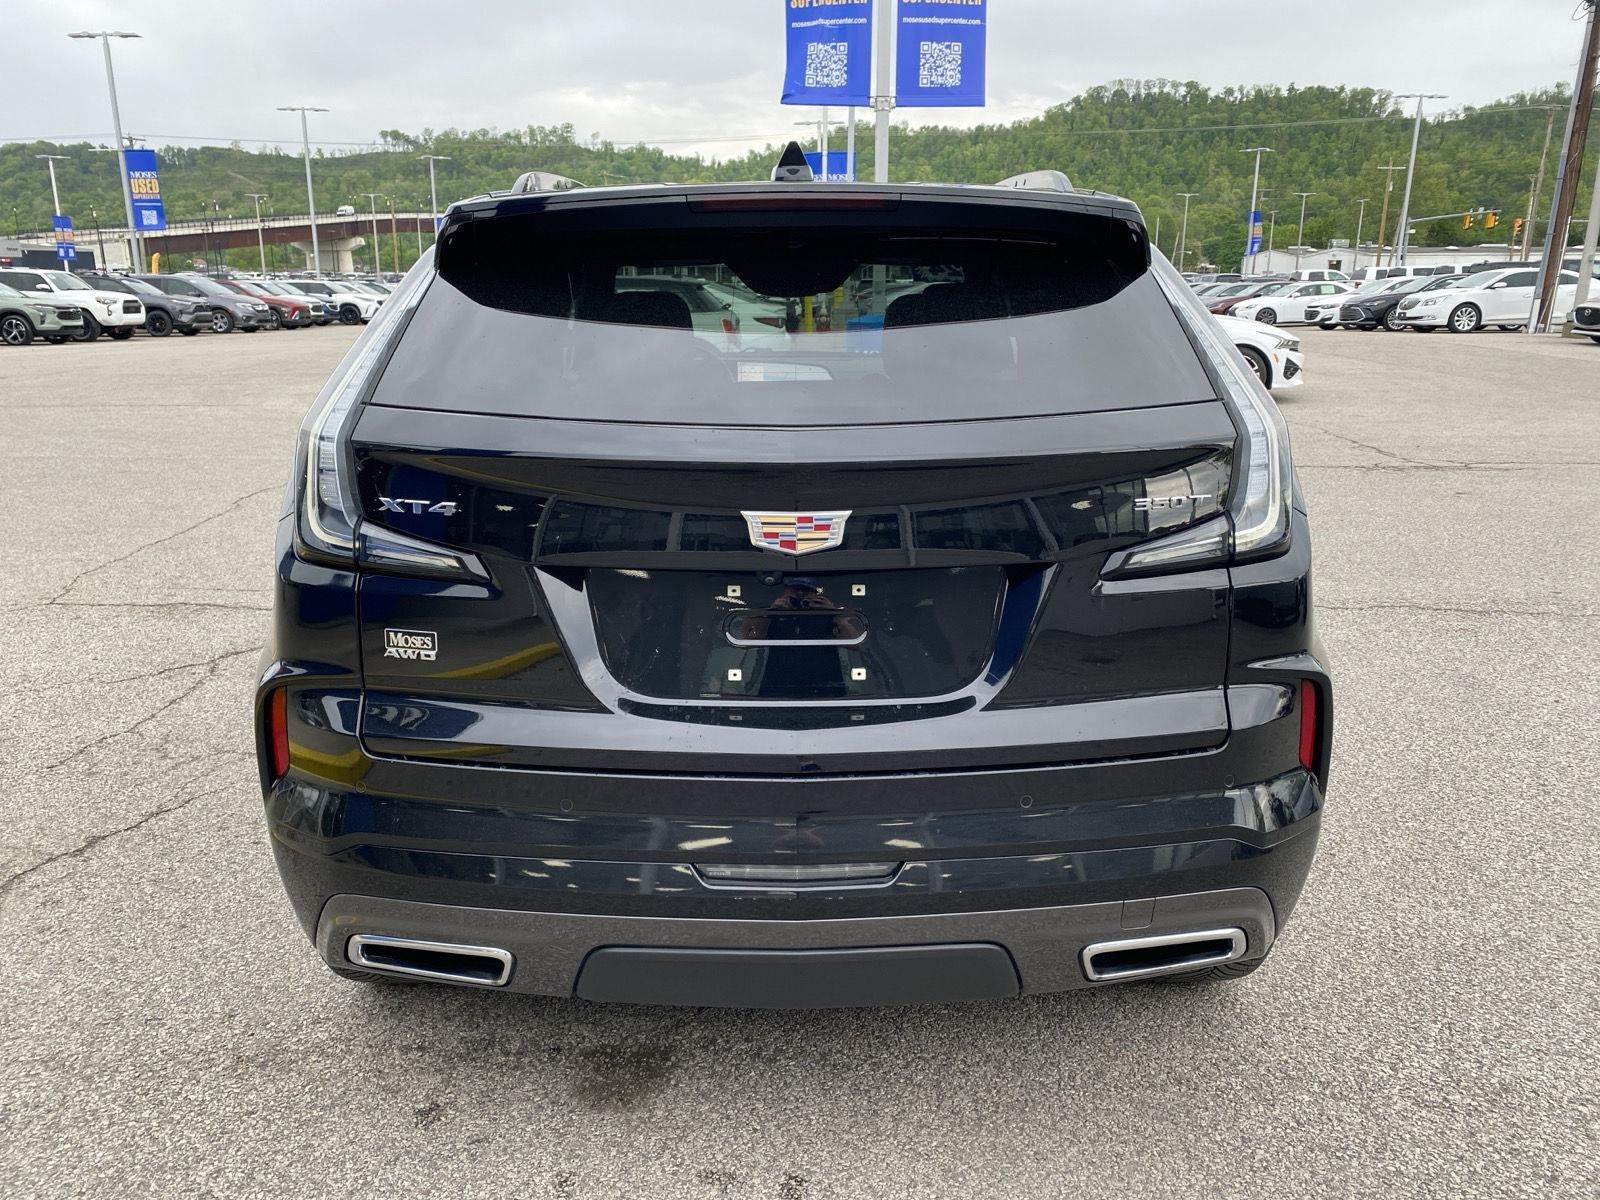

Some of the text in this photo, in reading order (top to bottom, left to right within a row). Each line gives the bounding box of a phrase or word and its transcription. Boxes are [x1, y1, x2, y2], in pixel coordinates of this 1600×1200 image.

[791, 17, 868, 28] mosesusedsupercenter.com
[902, 16, 981, 25] mosesusedsupercenter.com
[130, 178, 160, 193] USED
[378, 497, 458, 516] XT4
[384, 647, 437, 661] AWD
